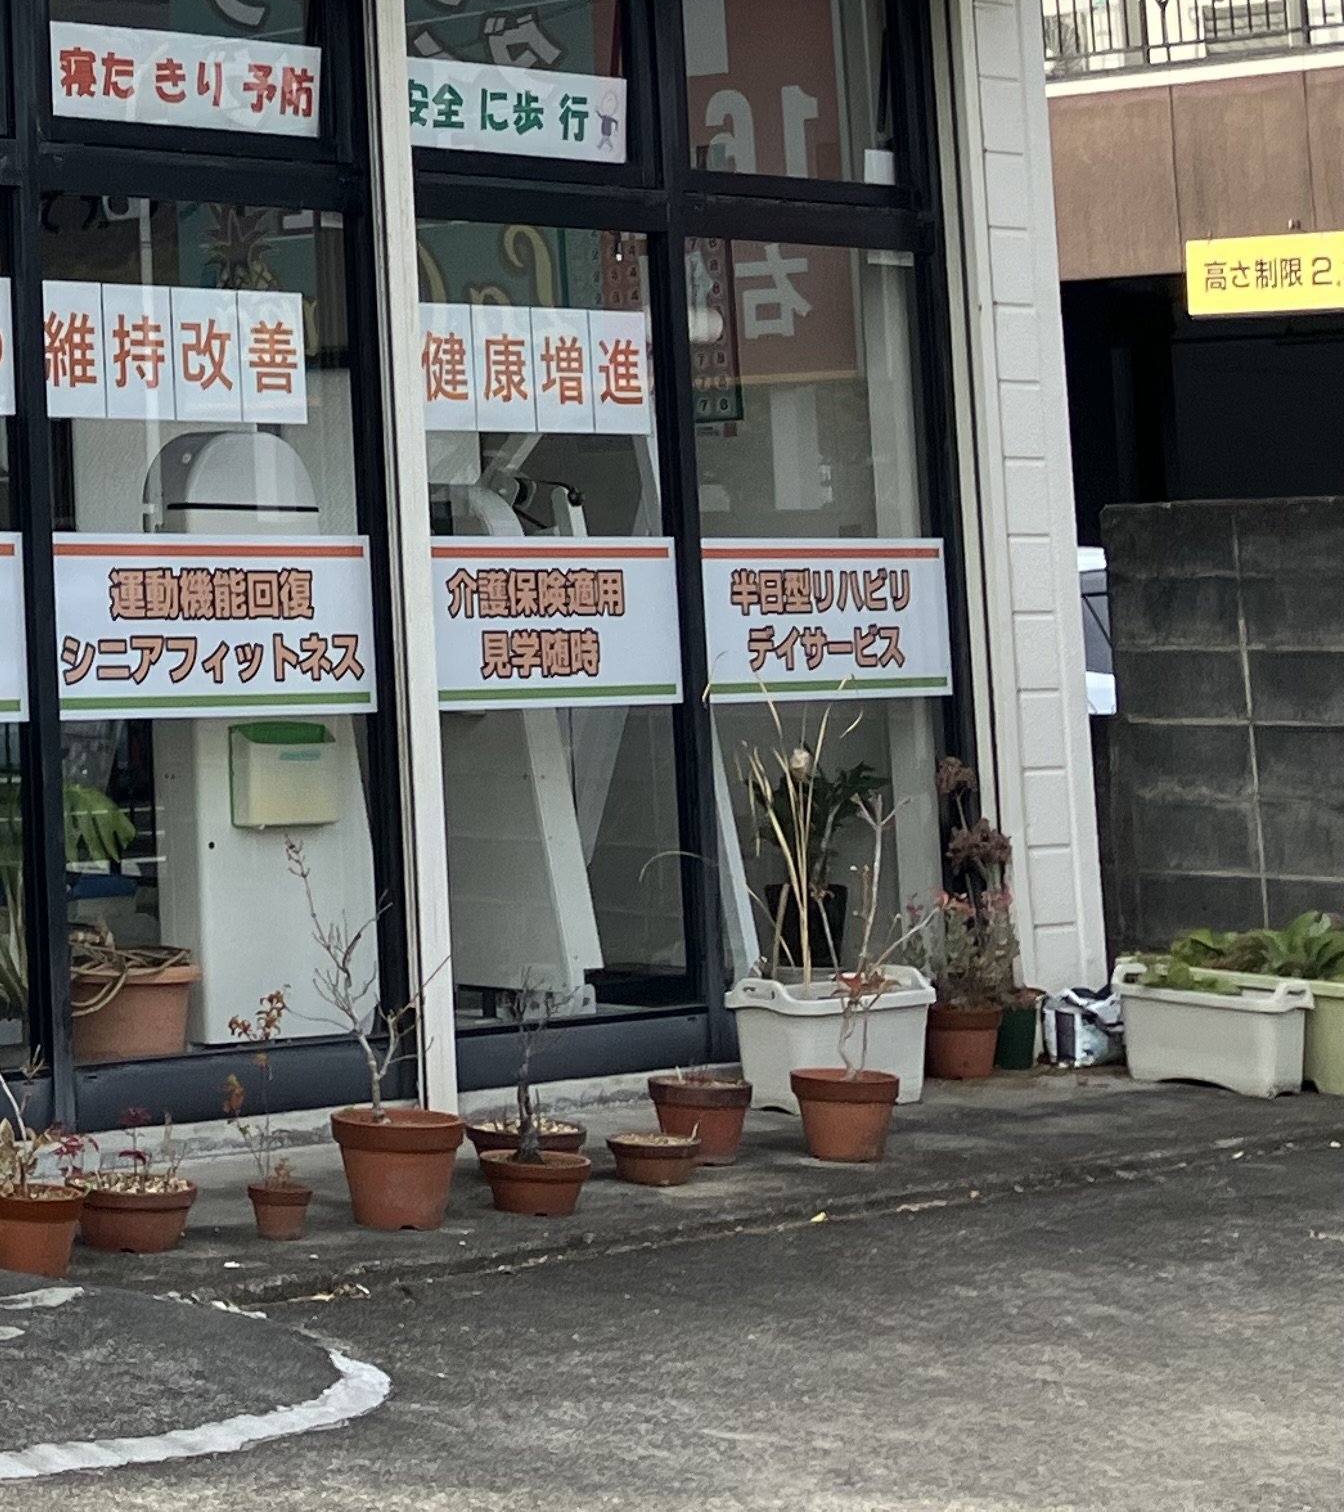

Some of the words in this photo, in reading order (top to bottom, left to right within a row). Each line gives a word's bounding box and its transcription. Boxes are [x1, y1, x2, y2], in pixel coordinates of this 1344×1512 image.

[60, 47, 314, 118] 寝たきり予防
[408, 78, 589, 142] 安全に歩行
[1204, 257, 1304, 292] 高さ制限
[1311, 256, 1344, 287] 2.
[43, 311, 298, 395] 維持改善
[421, 329, 644, 408] 健康増進
[108, 567, 314, 620] 運動機能回復
[446, 568, 625, 618] 介護保険適用
[729, 568, 911, 616] 半日型リハビリ
[61, 632, 364, 685] シニアフィットネス
[481, 627, 600, 680] 見学随時
[747, 626, 905, 672] デイサービス
